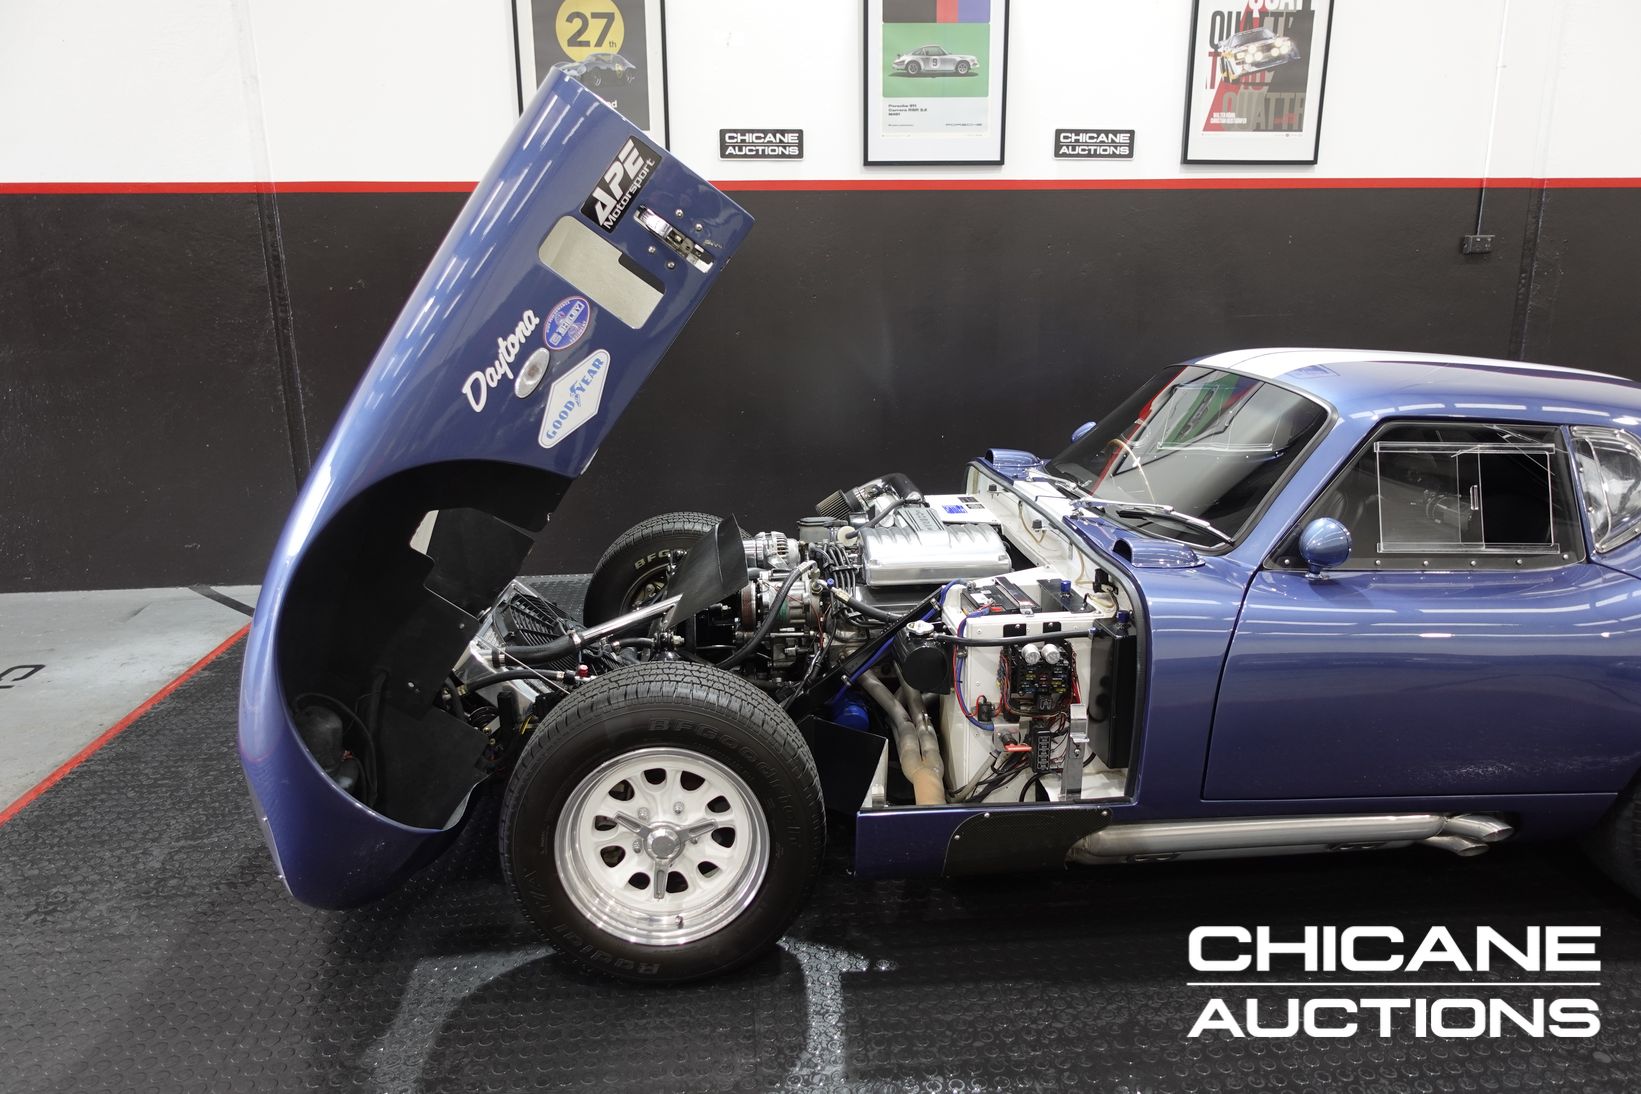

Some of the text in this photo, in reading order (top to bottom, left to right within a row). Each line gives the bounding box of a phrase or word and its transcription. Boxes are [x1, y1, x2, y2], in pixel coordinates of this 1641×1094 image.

[725, 132, 799, 143] CHICANE
[1060, 132, 1130, 143] CHICANE
[725, 146, 799, 155] AUCTIONS
[1059, 146, 1130, 155] AUCTIONS
[592, 139, 644, 226] APE
[604, 158, 655, 229] Motorsport
[462, 309, 540, 413] Daytona
